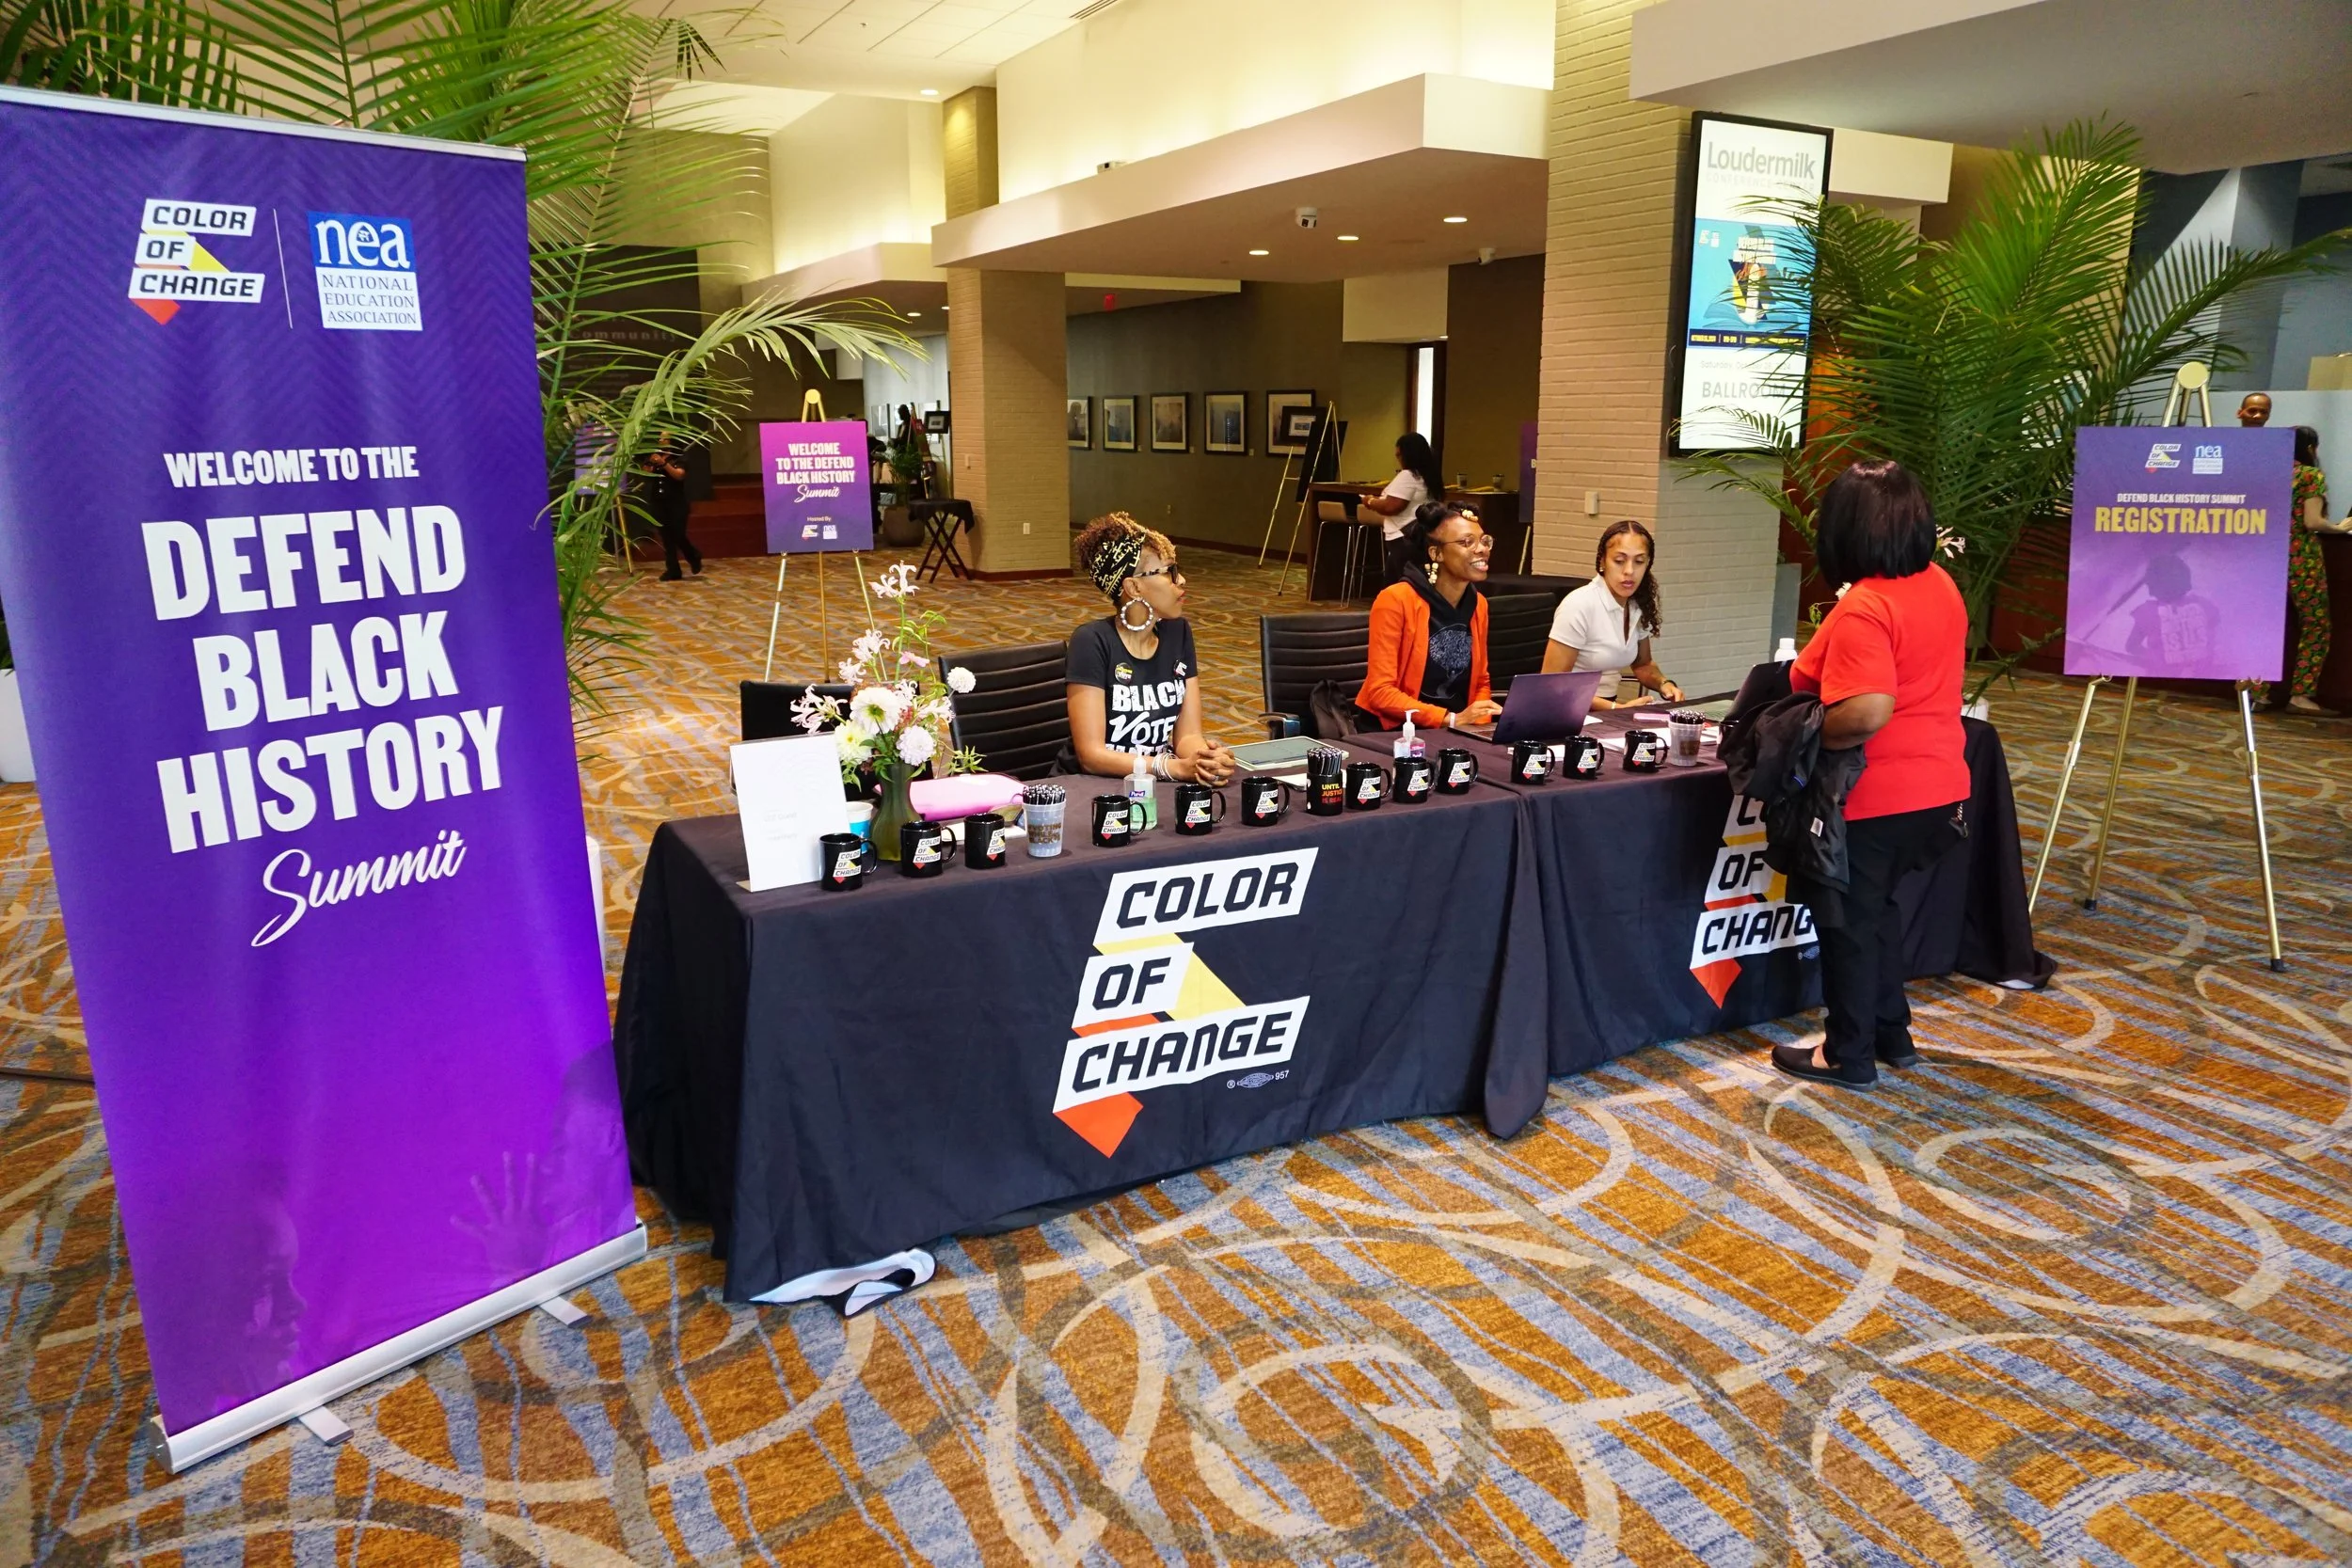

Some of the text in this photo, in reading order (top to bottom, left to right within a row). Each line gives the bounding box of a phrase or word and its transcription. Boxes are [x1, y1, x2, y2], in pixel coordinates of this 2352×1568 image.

[1707, 141, 1817, 180] Loudermilk
[151, 205, 247, 230] COLOR
[145, 240, 185, 260] OF
[315, 219, 411, 269] nea
[138, 274, 256, 297] CHANGE
[322, 274, 413, 292] NATIONAL
[324, 293, 415, 309] EDUCATION
[327, 310, 418, 325] ASSOCIATION
[568, 329, 676, 342] Community
[1702, 381, 1787, 399] BALLROOM
[788, 442, 841, 456] WELCOME
[2195, 445, 2222, 458] nea
[164, 445, 421, 488] WELCOME TO THE
[775, 456, 854, 470] TO THE DEFEND
[776, 470, 855, 484] BLACK HISTORY
[794, 484, 840, 502] Summit
[2117, 493, 2246, 504] DEFEND BLACK HISTORY SUMMIT
[2094, 506, 2266, 535] REGISTRATION
[141, 504, 467, 621] DEFEND
[193, 610, 460, 732] BLACK
[1112, 679, 1185, 712] BLACK
[156, 705, 504, 854] HISTORY
[920, 837, 940, 846] COLOR
[914, 853, 940, 862] CHANGE
[1718, 849, 1766, 891] OF
[251, 829, 467, 947] Summit
[1116, 862, 1299, 929] COLOR
[1701, 904, 1813, 955] CHANG
[1092, 957, 1171, 1010] OF
[1072, 1011, 1293, 1093] CHANGE
[1275, 1069, 1289, 1080] 957
